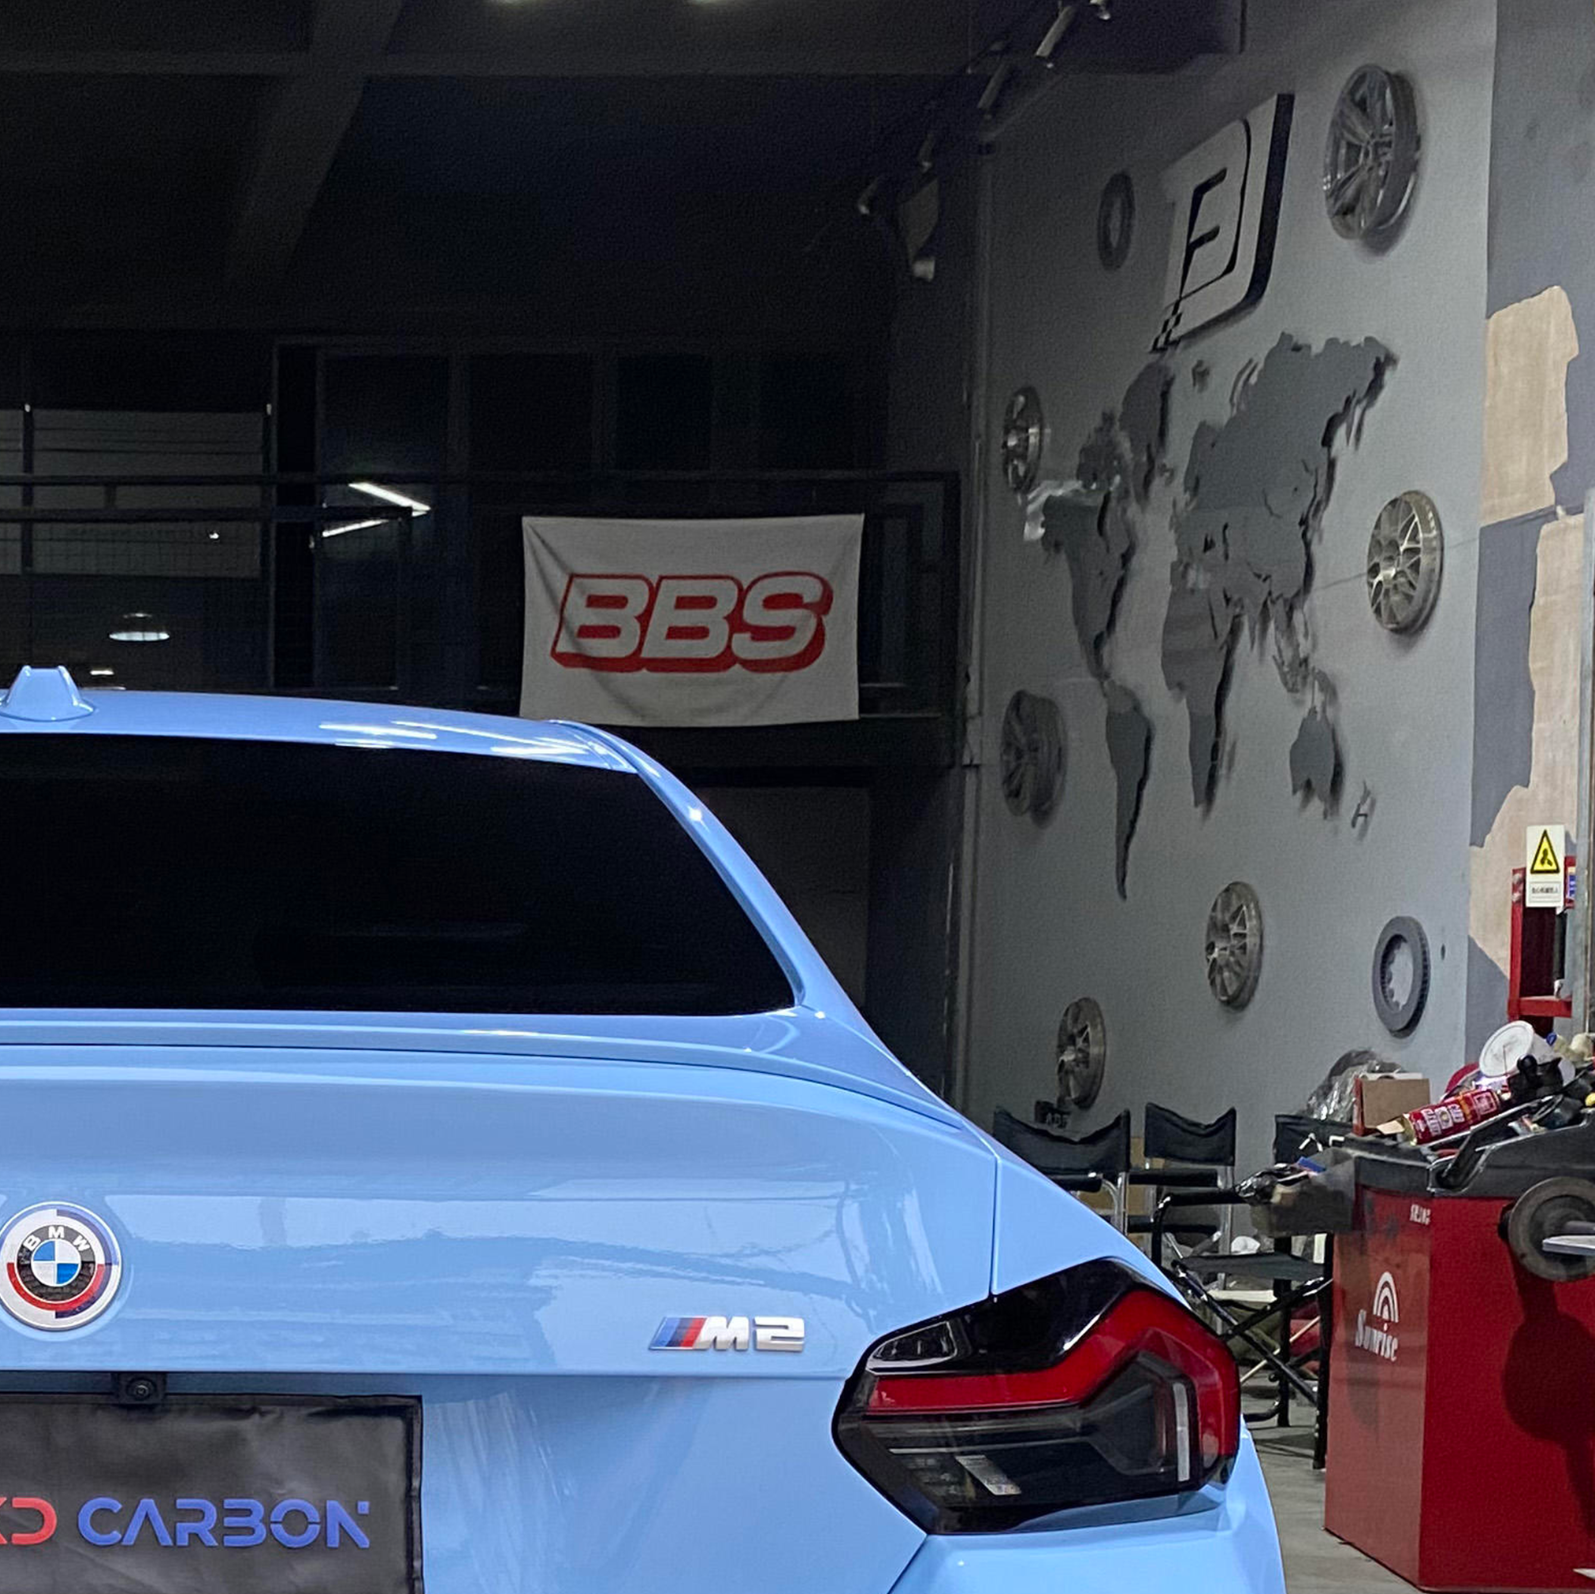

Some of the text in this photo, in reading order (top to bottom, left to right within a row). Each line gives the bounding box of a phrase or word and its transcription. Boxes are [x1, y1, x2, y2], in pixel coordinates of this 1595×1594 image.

[550, 570, 834, 674] BBS
[22, 1226, 90, 1252] BMW
[692, 1315, 805, 1352] M2
[1355, 1309, 1399, 1362] Sunrise
[77, 1496, 371, 1549] CARBON
